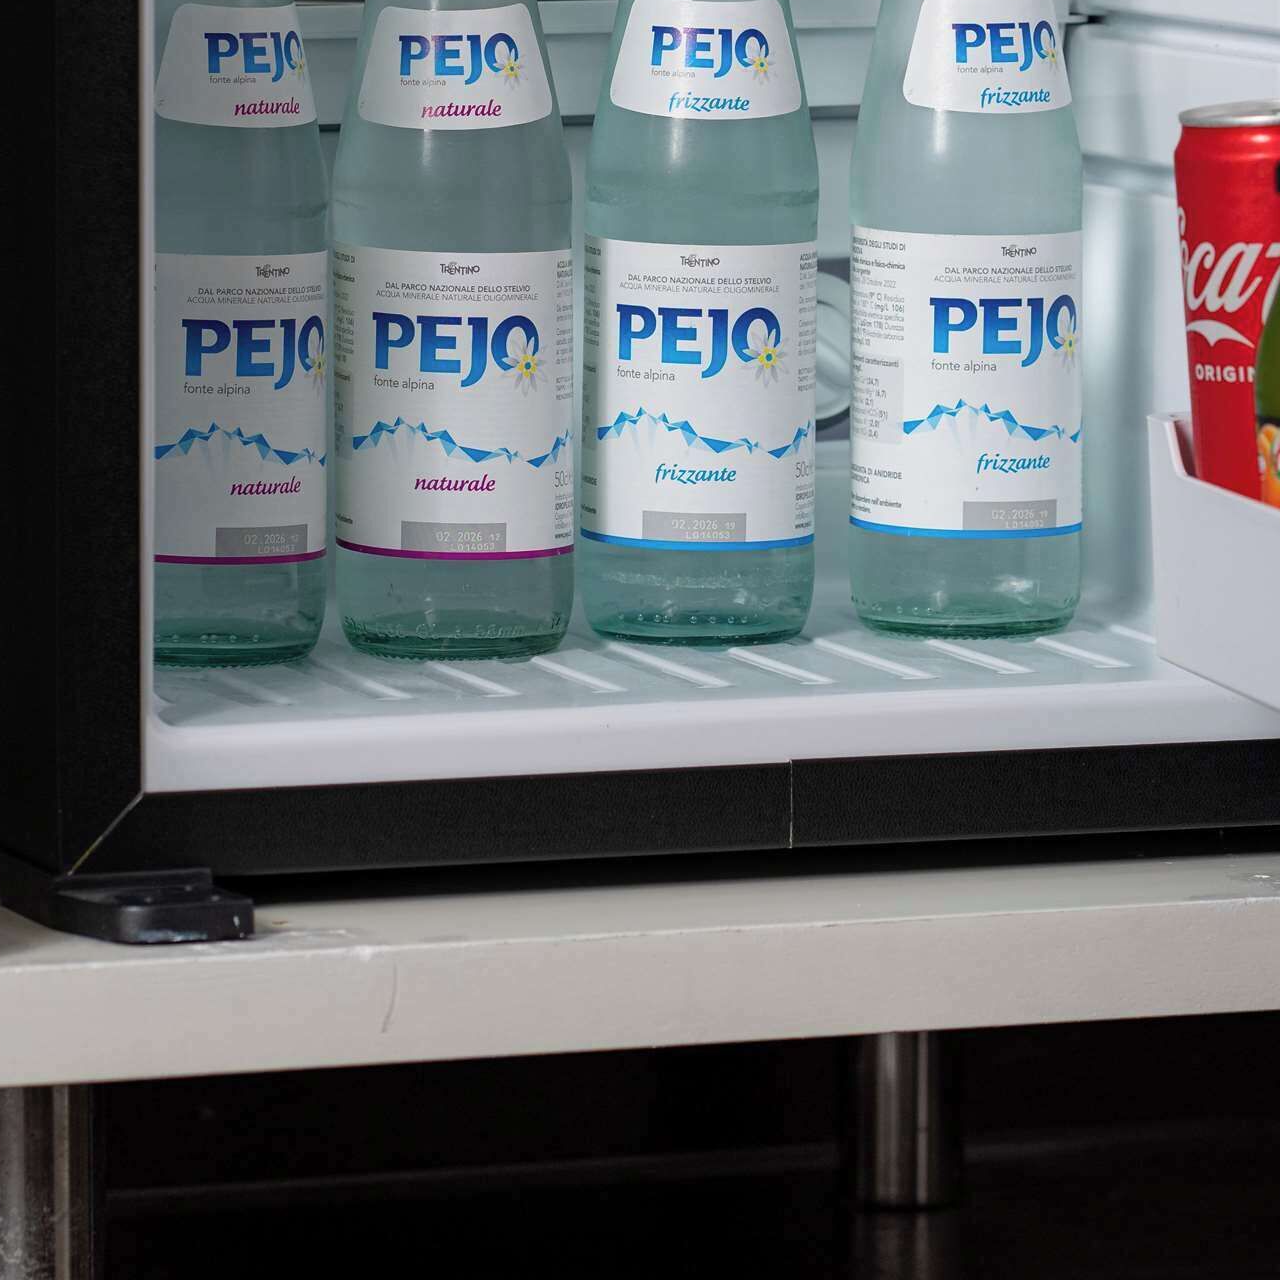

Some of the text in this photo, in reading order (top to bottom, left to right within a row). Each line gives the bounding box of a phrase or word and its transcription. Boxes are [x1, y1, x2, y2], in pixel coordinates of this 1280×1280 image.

[651, 25, 770, 79] PEJO
[951, 20, 1056, 72] PEJO
[204, 30, 303, 83] PEJO
[398, 32, 519, 85] PEJO
[980, 66, 1004, 76] alpina
[400, 78, 420, 88] fonte
[234, 97, 300, 116] naturale
[668, 92, 750, 113] frizzante
[980, 87, 1051, 109] frizzante
[421, 99, 502, 118] naturale
[1001, 246, 1037, 258] TRENTINO
[439, 263, 480, 276] TRENTINO
[680, 256, 720, 268] TRENTINO
[944, 266, 961, 274] DAL
[962, 266, 989, 275] PARCO
[990, 266, 1034, 275] NAZIONALE
[255, 266, 290, 278] TRENTINO
[627, 273, 772, 285] DAL PARCO NAZIONALE DELLO STELVIO
[934, 275, 962, 284] ACQUA
[198, 287, 214, 295] DAL
[216, 287, 243, 296] PARCO
[245, 287, 287, 296] NAZIONALE
[376, 290, 401, 300] ACQUA
[402, 291, 440, 301] MINERALE
[442, 293, 482, 302] NATURALE
[385, 281, 531, 293] DAL PARCO NAZIONALE DELLO STELVIO
[644, 283, 681, 293] MINERALE
[682, 285, 722, 294] NATURALE
[723, 285, 781, 294] OLIGOMINERALE
[187, 296, 216, 305] ACQUA
[929, 294, 1077, 368] PEJO
[372, 311, 540, 388] PEJO
[616, 303, 782, 379] PEJO
[181, 315, 325, 390] PEJO
[616, 365, 676, 383] fonte alpina
[931, 358, 997, 374] fonte alpina
[183, 382, 251, 397] fonte alpina
[373, 374, 435, 393] fonte alpina
[976, 453, 1050, 474] frizzante
[414, 473, 496, 492] naturale
[655, 463, 737, 484] frizzante
[230, 475, 302, 495] naturale
